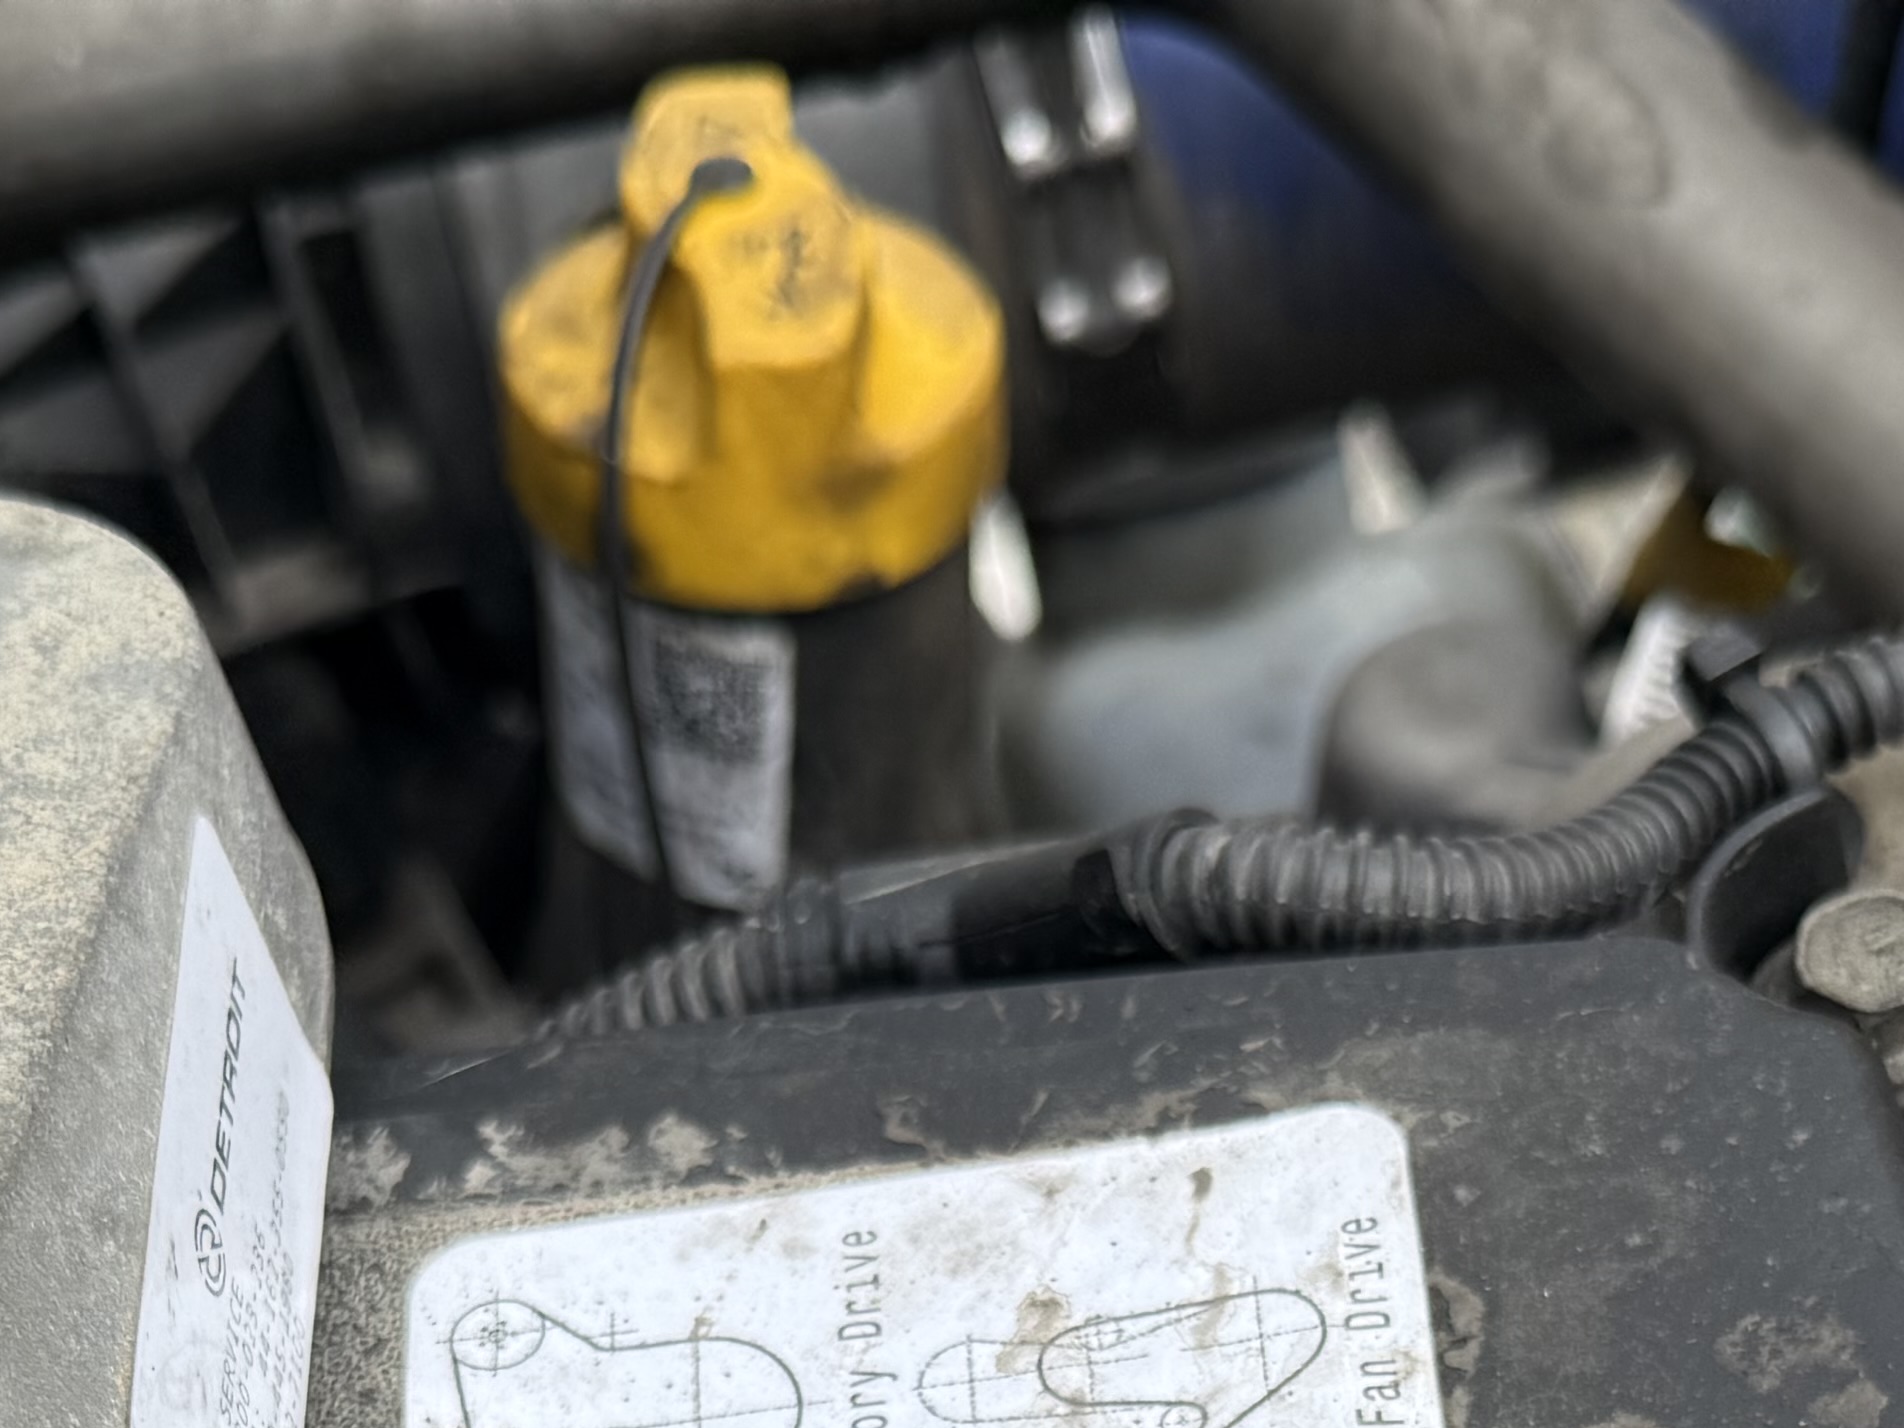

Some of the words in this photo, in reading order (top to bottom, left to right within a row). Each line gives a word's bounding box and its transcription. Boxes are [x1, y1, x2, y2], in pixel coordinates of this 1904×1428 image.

[209, 951, 248, 1219] DETROIT
[837, 1229, 882, 1341] Drive
[1340, 1216, 1392, 1331] Drive
[1355, 1359, 1405, 1426] Fan
